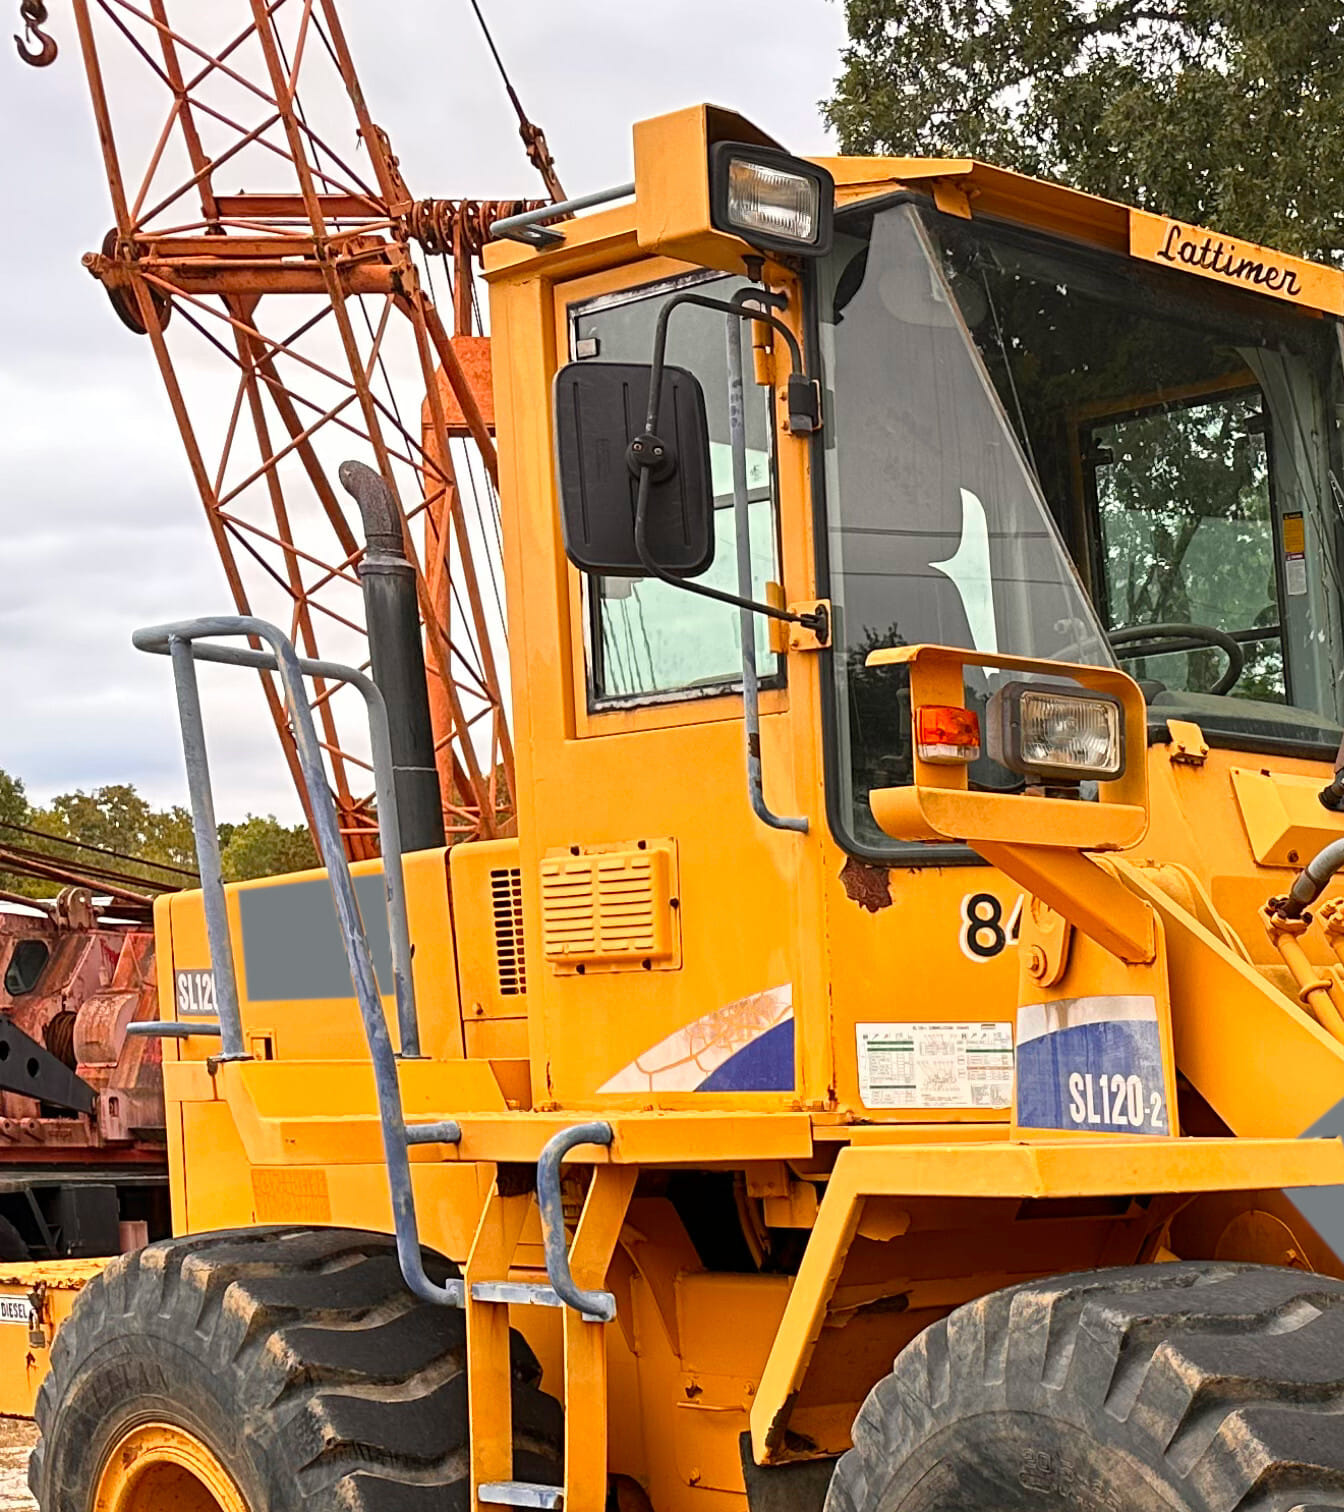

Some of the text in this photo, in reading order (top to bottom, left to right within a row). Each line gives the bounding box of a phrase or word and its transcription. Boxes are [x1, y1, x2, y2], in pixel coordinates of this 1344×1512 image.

[1157, 225, 1302, 296] Lattimer
[959, 892, 1024, 962] 8
[1068, 1072, 1163, 1127] SL120-2
[0, 1302, 28, 1319] DIESEL
